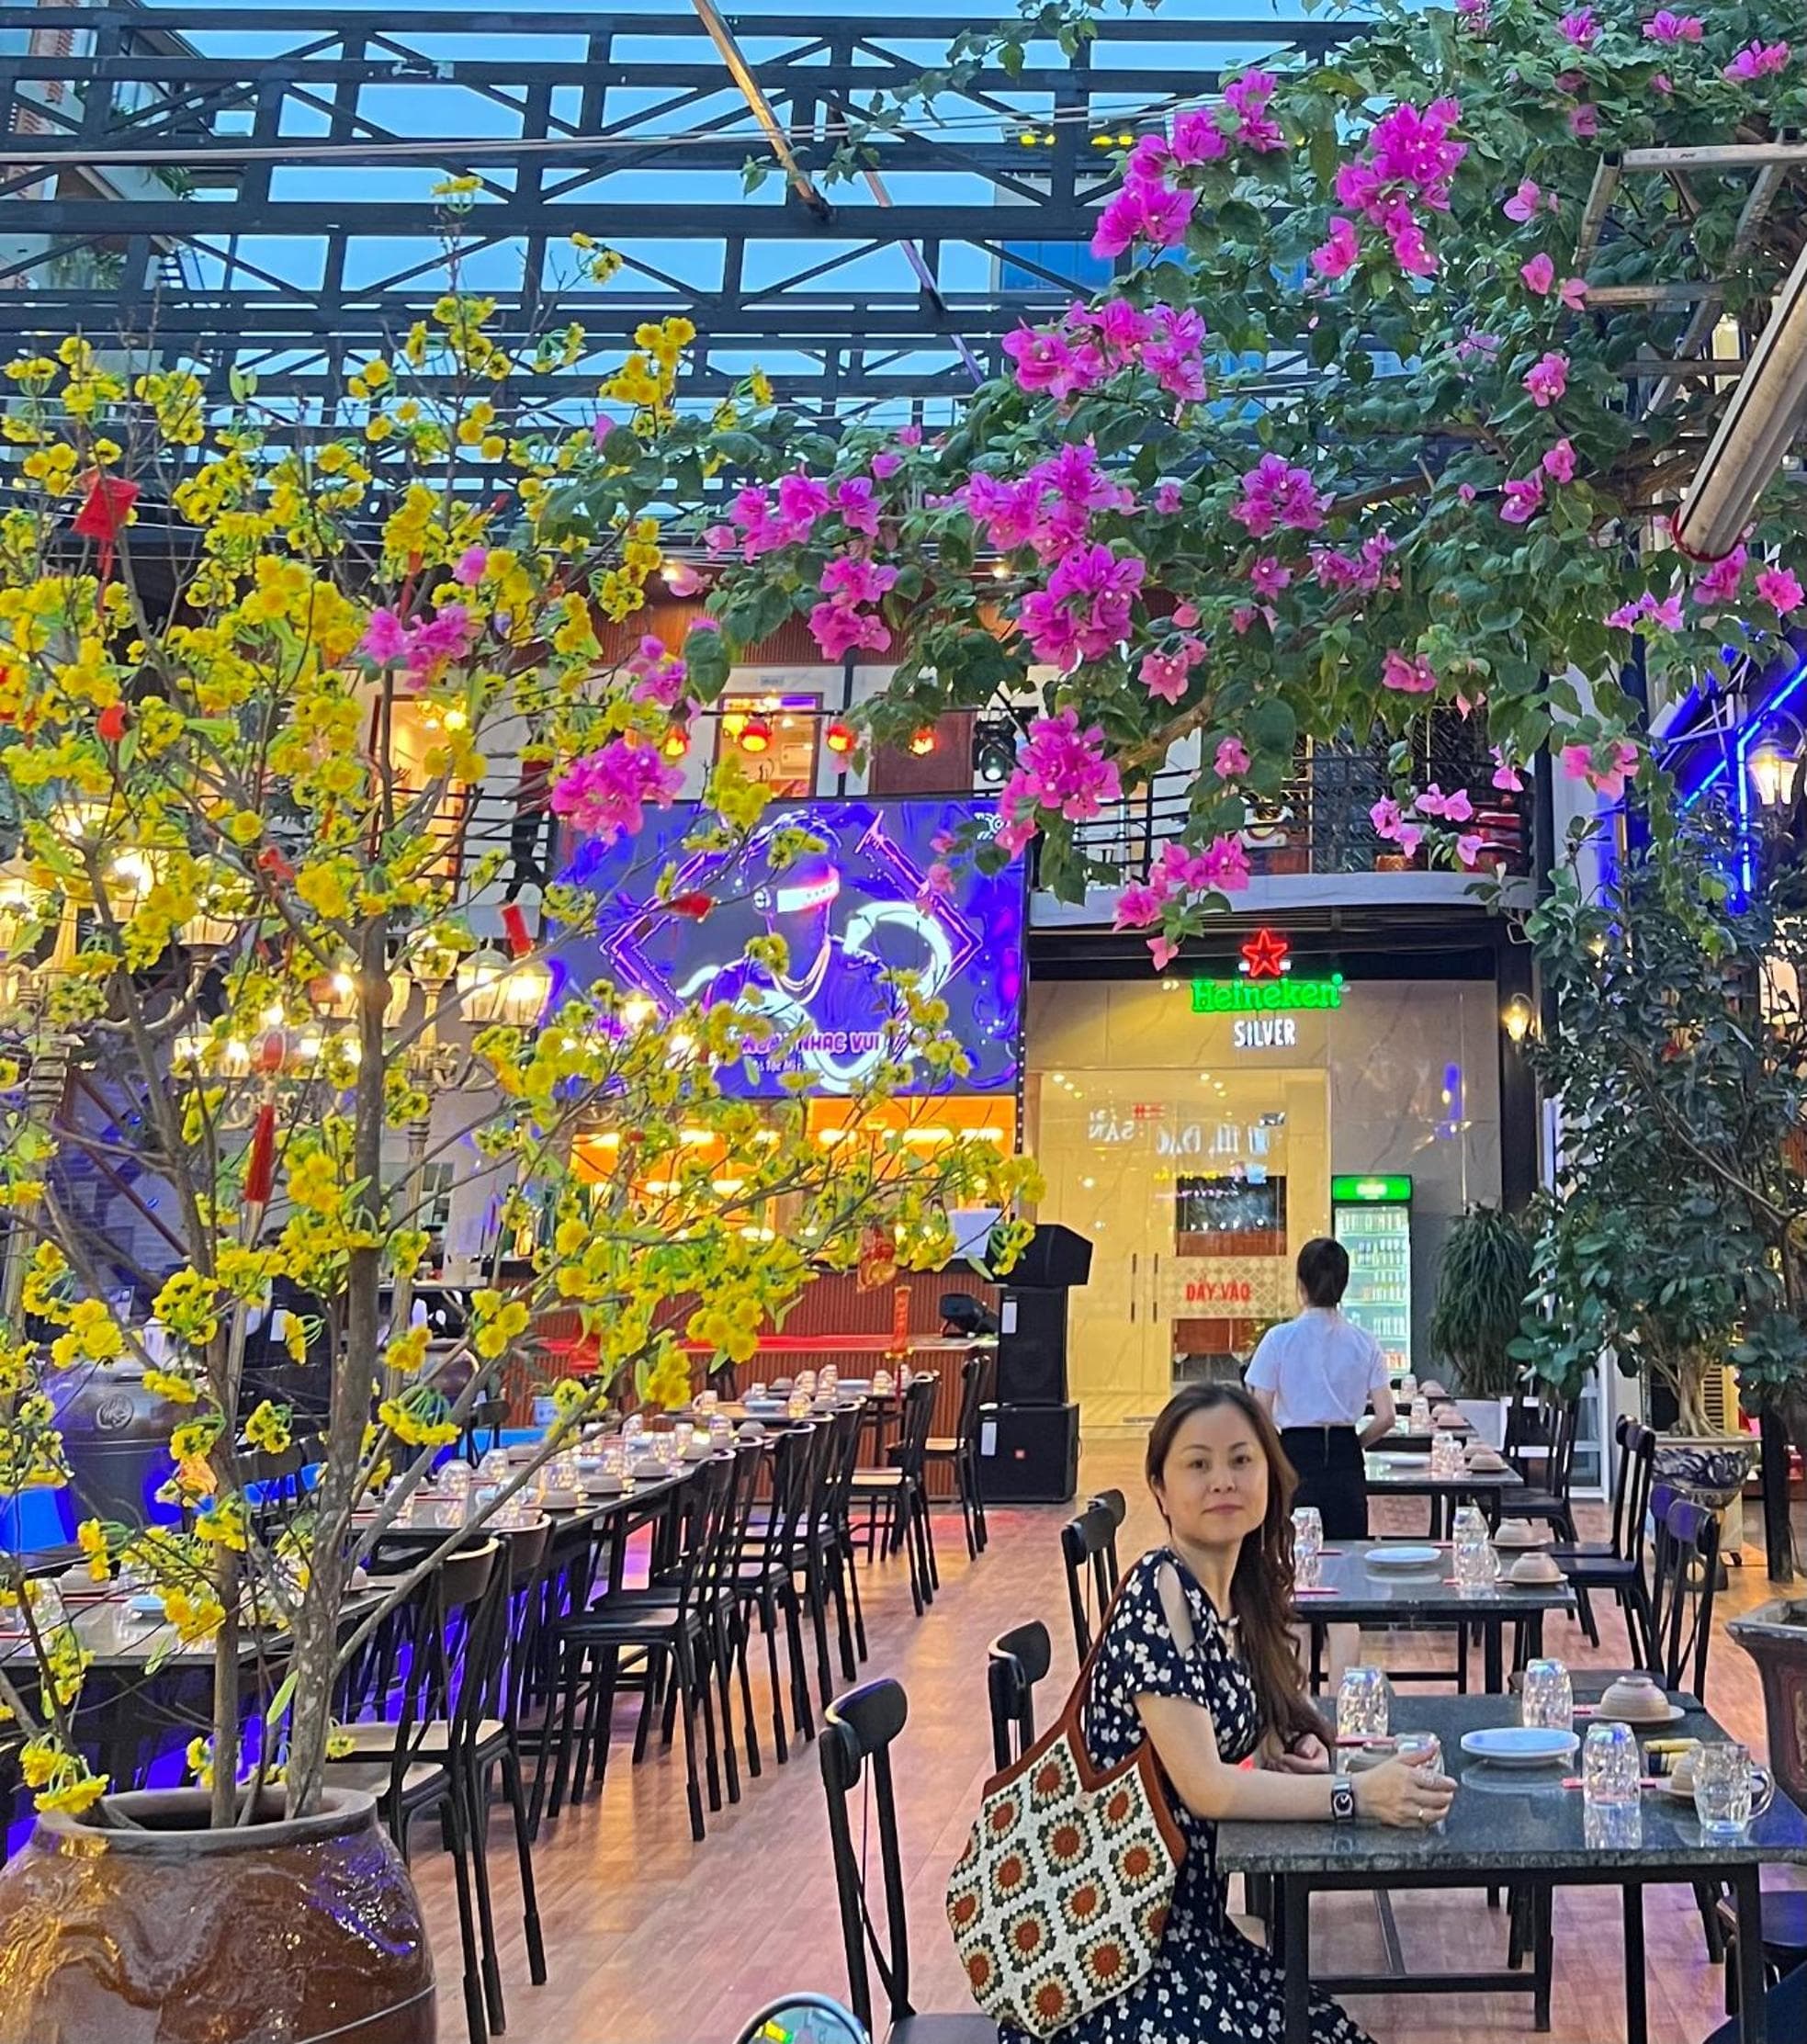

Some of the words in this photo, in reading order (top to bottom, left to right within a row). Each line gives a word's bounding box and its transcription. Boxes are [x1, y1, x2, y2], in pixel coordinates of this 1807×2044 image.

[1191, 978, 1340, 1011] Heineken
[850, 1033, 880, 1053] VUI
[1234, 1019, 1295, 1046] SILVER
